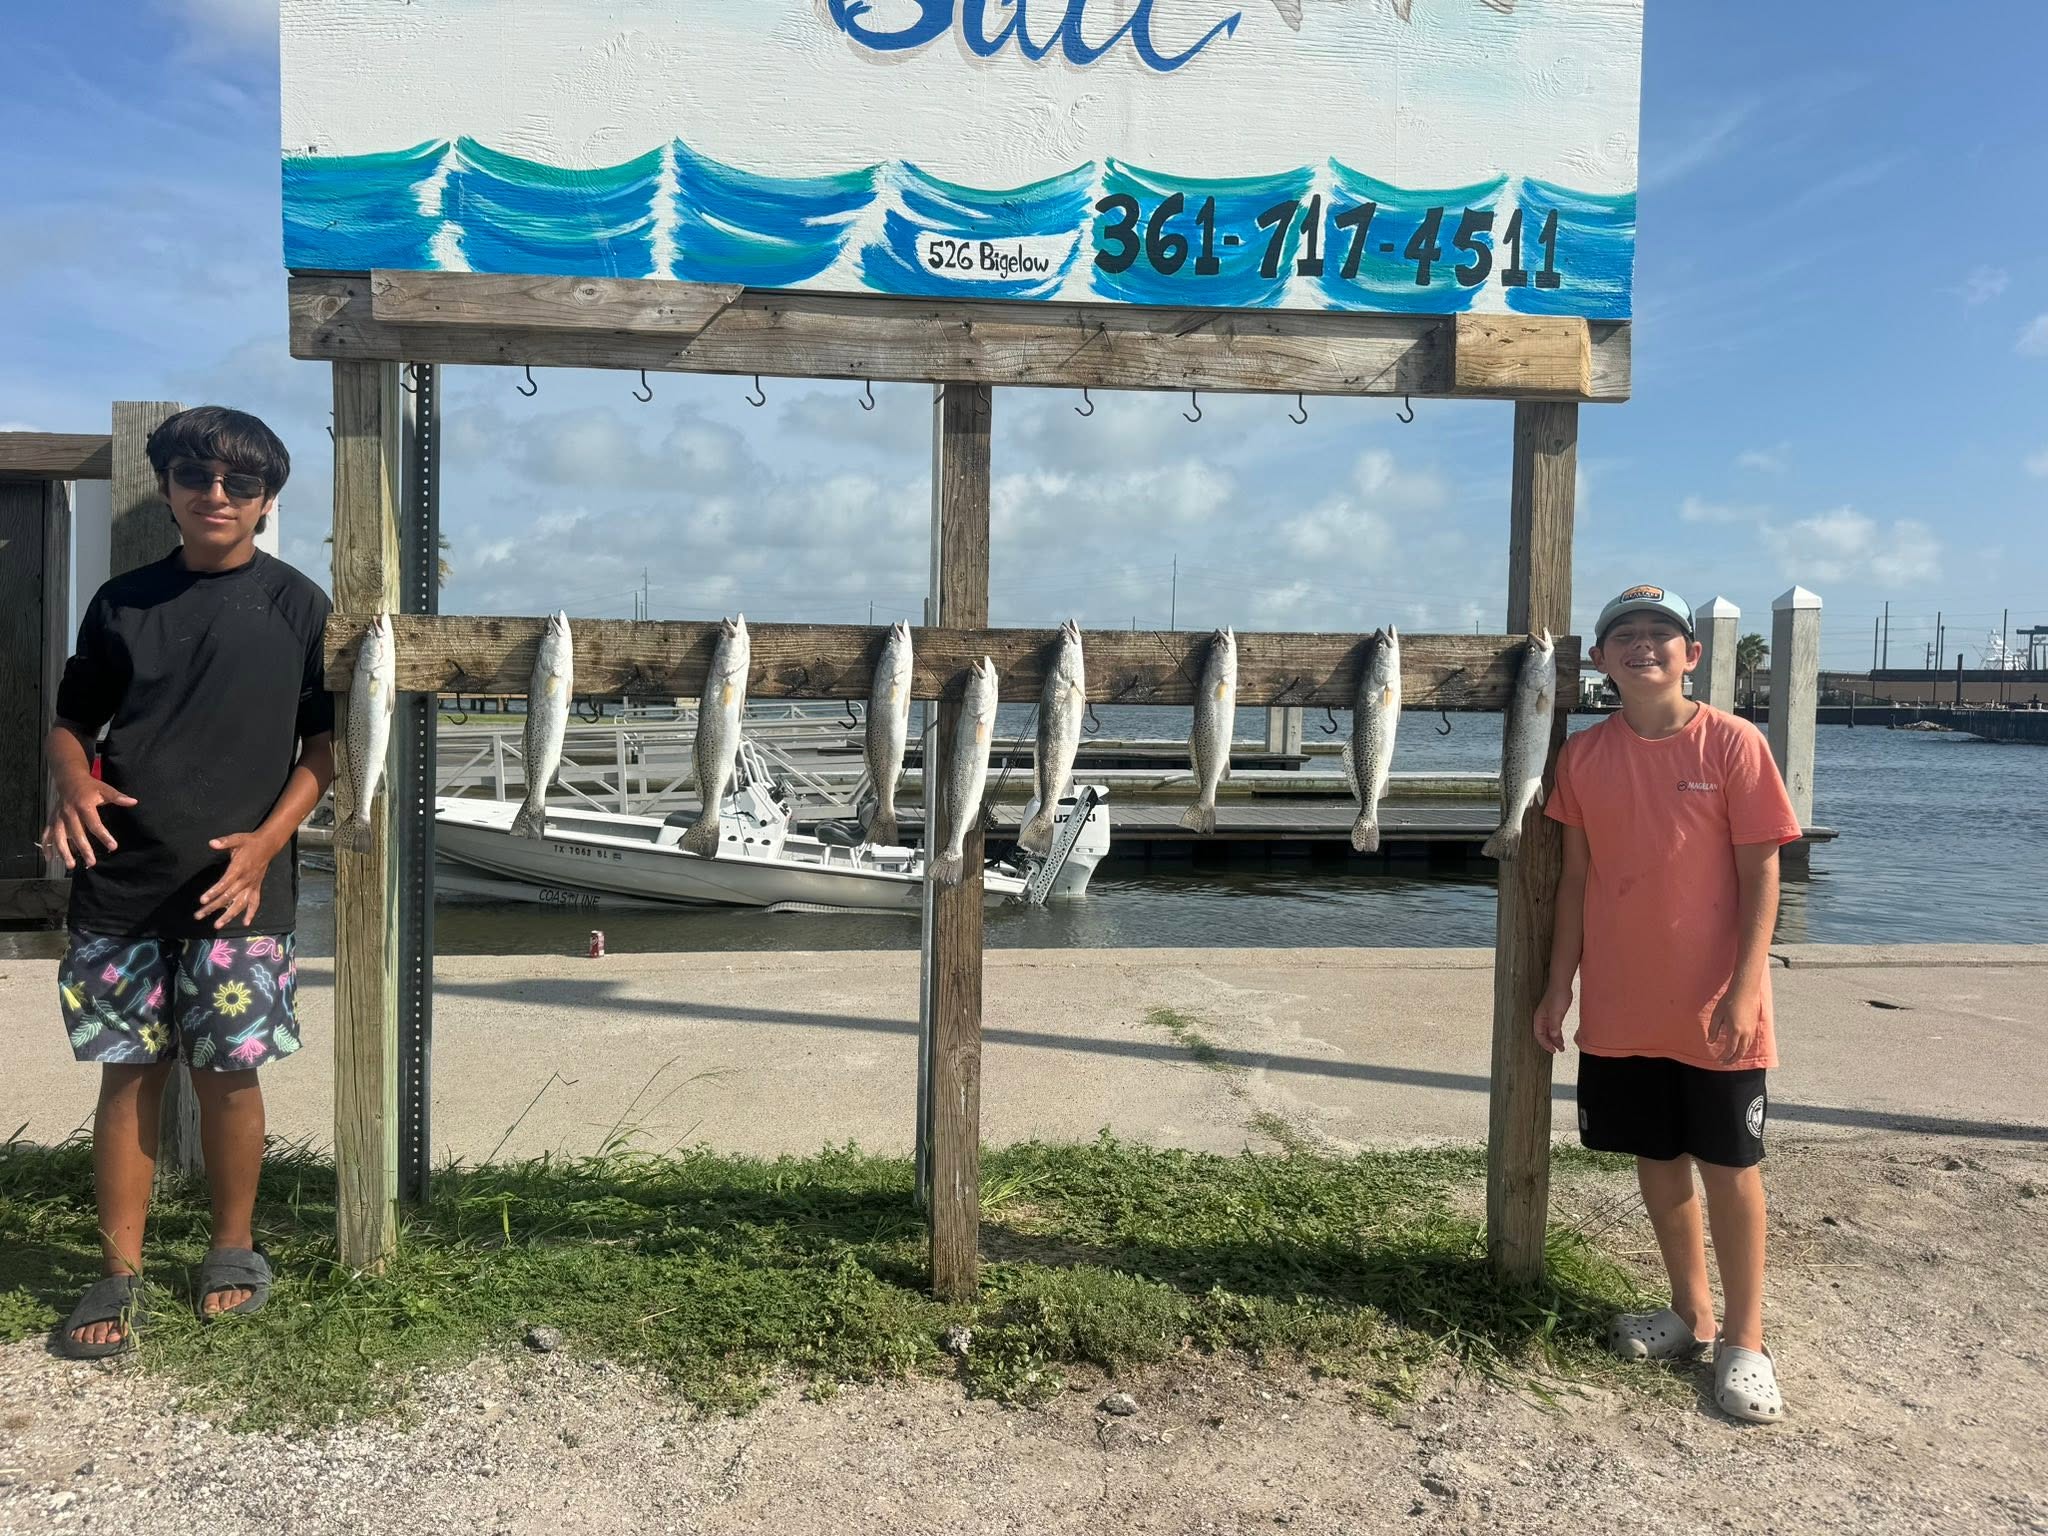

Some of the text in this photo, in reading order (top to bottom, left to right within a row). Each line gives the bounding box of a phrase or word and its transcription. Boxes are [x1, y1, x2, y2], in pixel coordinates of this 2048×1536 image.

[927, 240, 1050, 280] 526 Bigelow
[1094, 191, 1562, 289] 361-717-4511
[554, 844, 565, 854] TX
